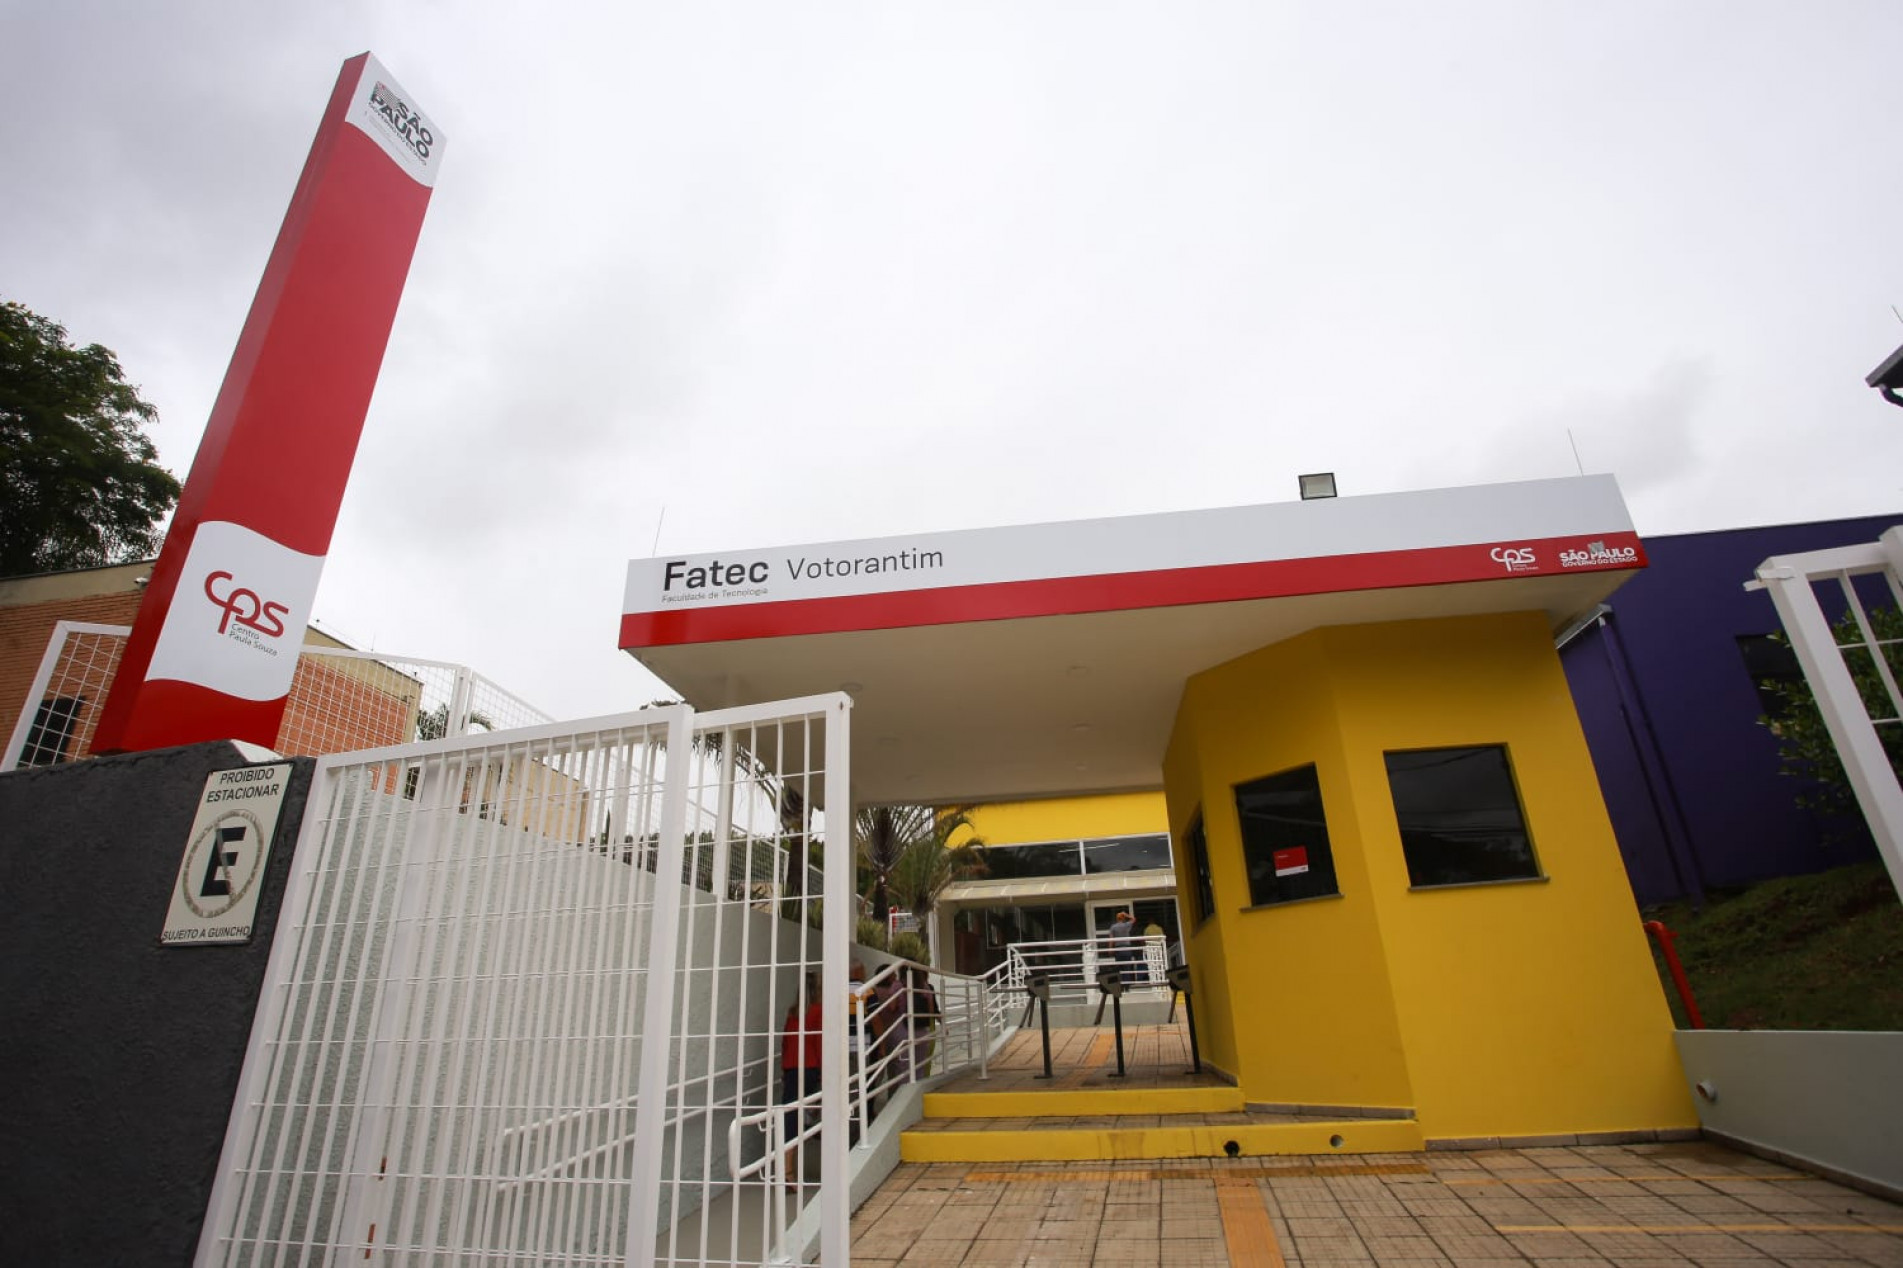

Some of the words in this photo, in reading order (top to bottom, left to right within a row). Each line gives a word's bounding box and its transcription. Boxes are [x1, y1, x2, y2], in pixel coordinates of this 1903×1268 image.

[370, 92, 430, 159] PAULO
[396, 98, 434, 147] SÃO
[1559, 549, 1588, 562] SÃO
[1590, 547, 1635, 560] PAULO
[663, 560, 770, 591] Fatec
[786, 547, 943, 580] Votorantim
[661, 591, 706, 603] Faculdade
[708, 590, 720, 600] de
[722, 586, 769, 598] Tecnologia
[231, 623, 260, 640] Centro
[229, 630, 252, 646] Paula
[253, 640, 278, 657] Souza
[219, 767, 275, 785] PROIBIDO
[206, 783, 281, 803] ESTACIONAR
[162, 927, 199, 941] SUJEITO
[199, 927, 207, 939] A
[207, 925, 251, 939] GUINCHO
